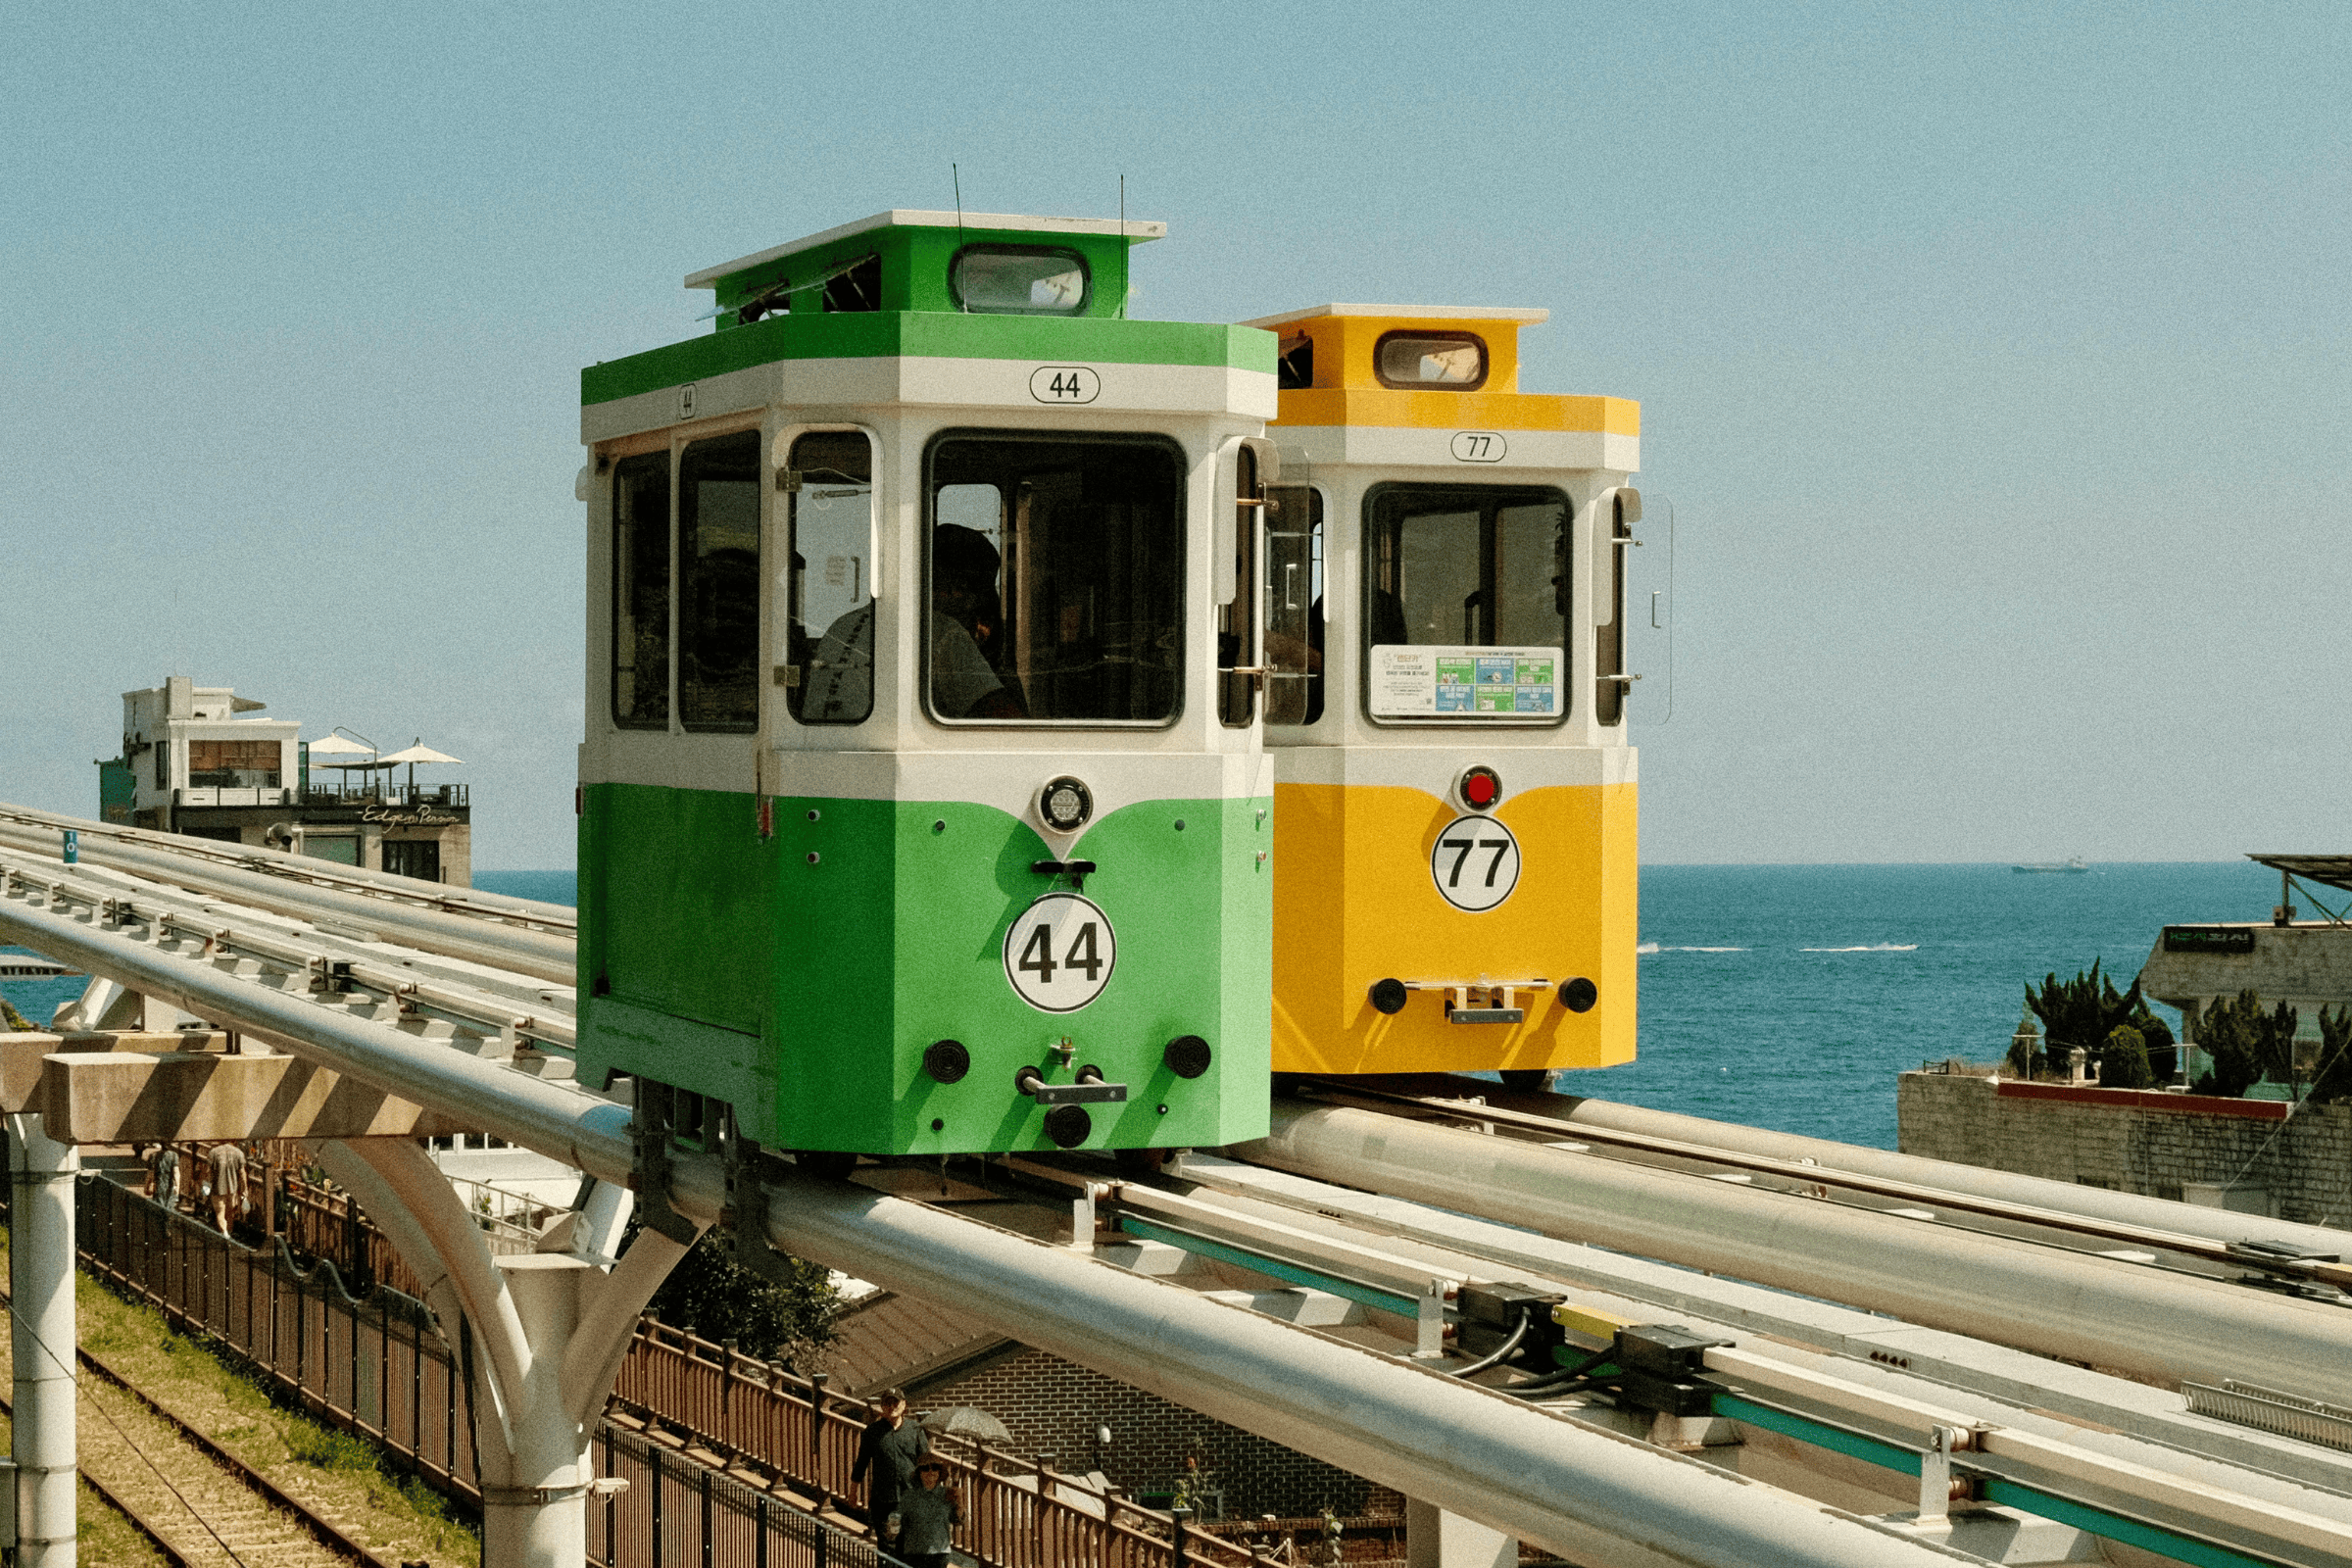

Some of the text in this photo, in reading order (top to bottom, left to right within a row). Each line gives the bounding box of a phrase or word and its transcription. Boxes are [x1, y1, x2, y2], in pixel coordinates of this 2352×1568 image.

[1050, 372, 1081, 398] 44
[1466, 436, 1491, 458] 77
[1442, 838, 1510, 889] 77
[1018, 922, 1102, 983] 44
